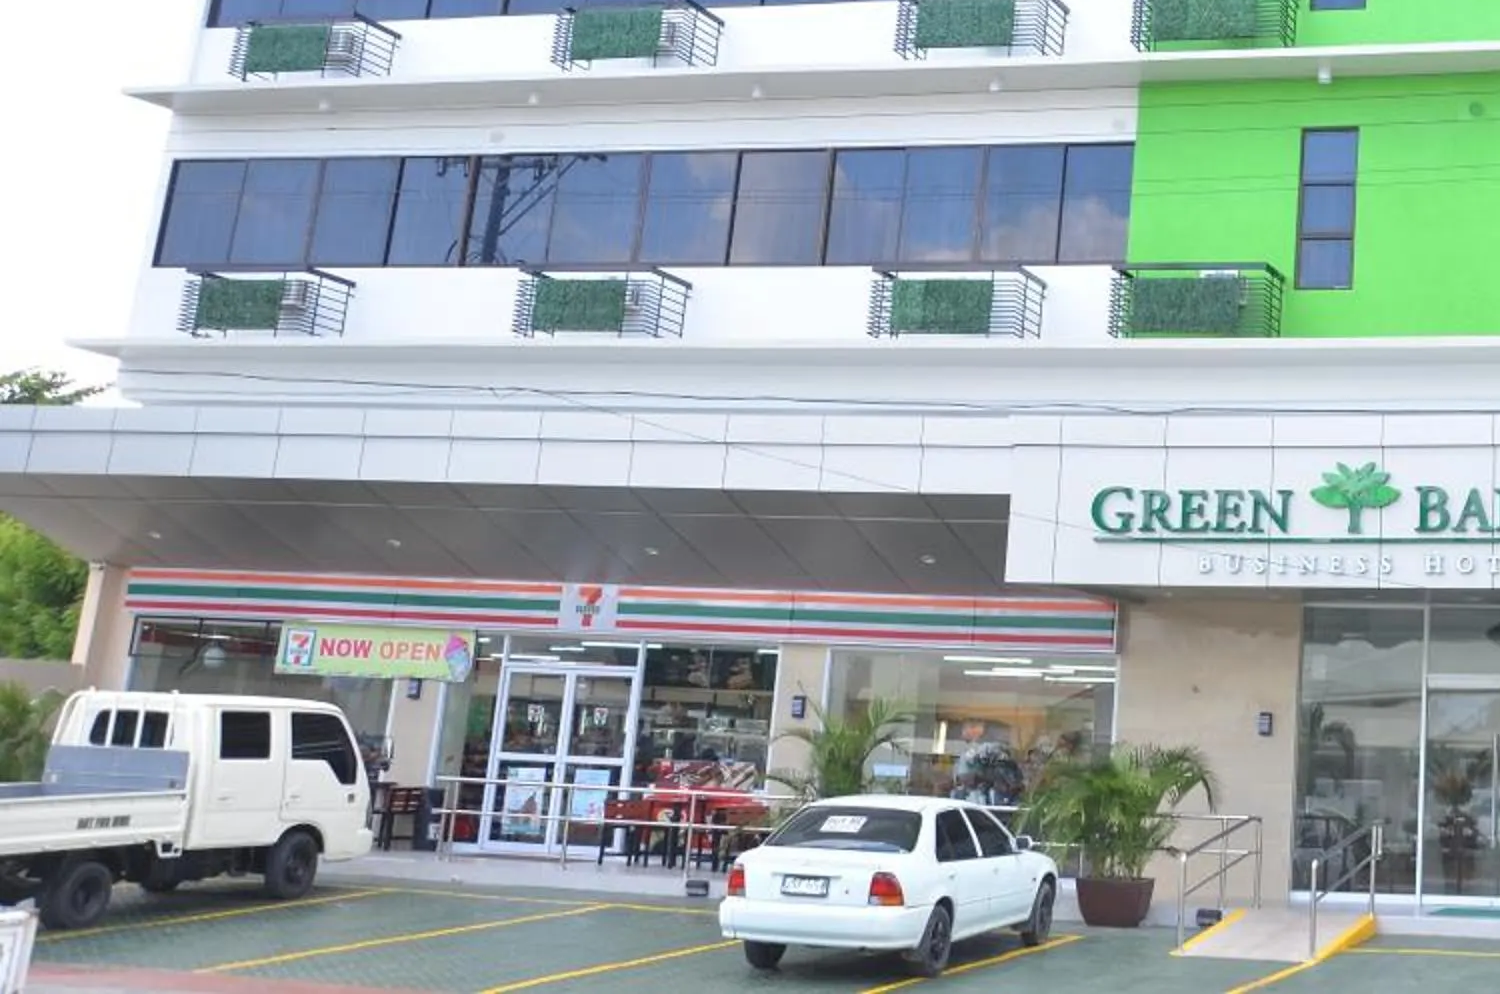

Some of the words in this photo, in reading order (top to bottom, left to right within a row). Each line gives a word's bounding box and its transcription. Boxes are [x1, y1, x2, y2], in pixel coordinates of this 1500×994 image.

[1091, 486, 1295, 534] GREEN
[1198, 554, 1394, 575] BUSINESS
[319, 637, 373, 659] NOW
[379, 641, 441, 662] OPEN
